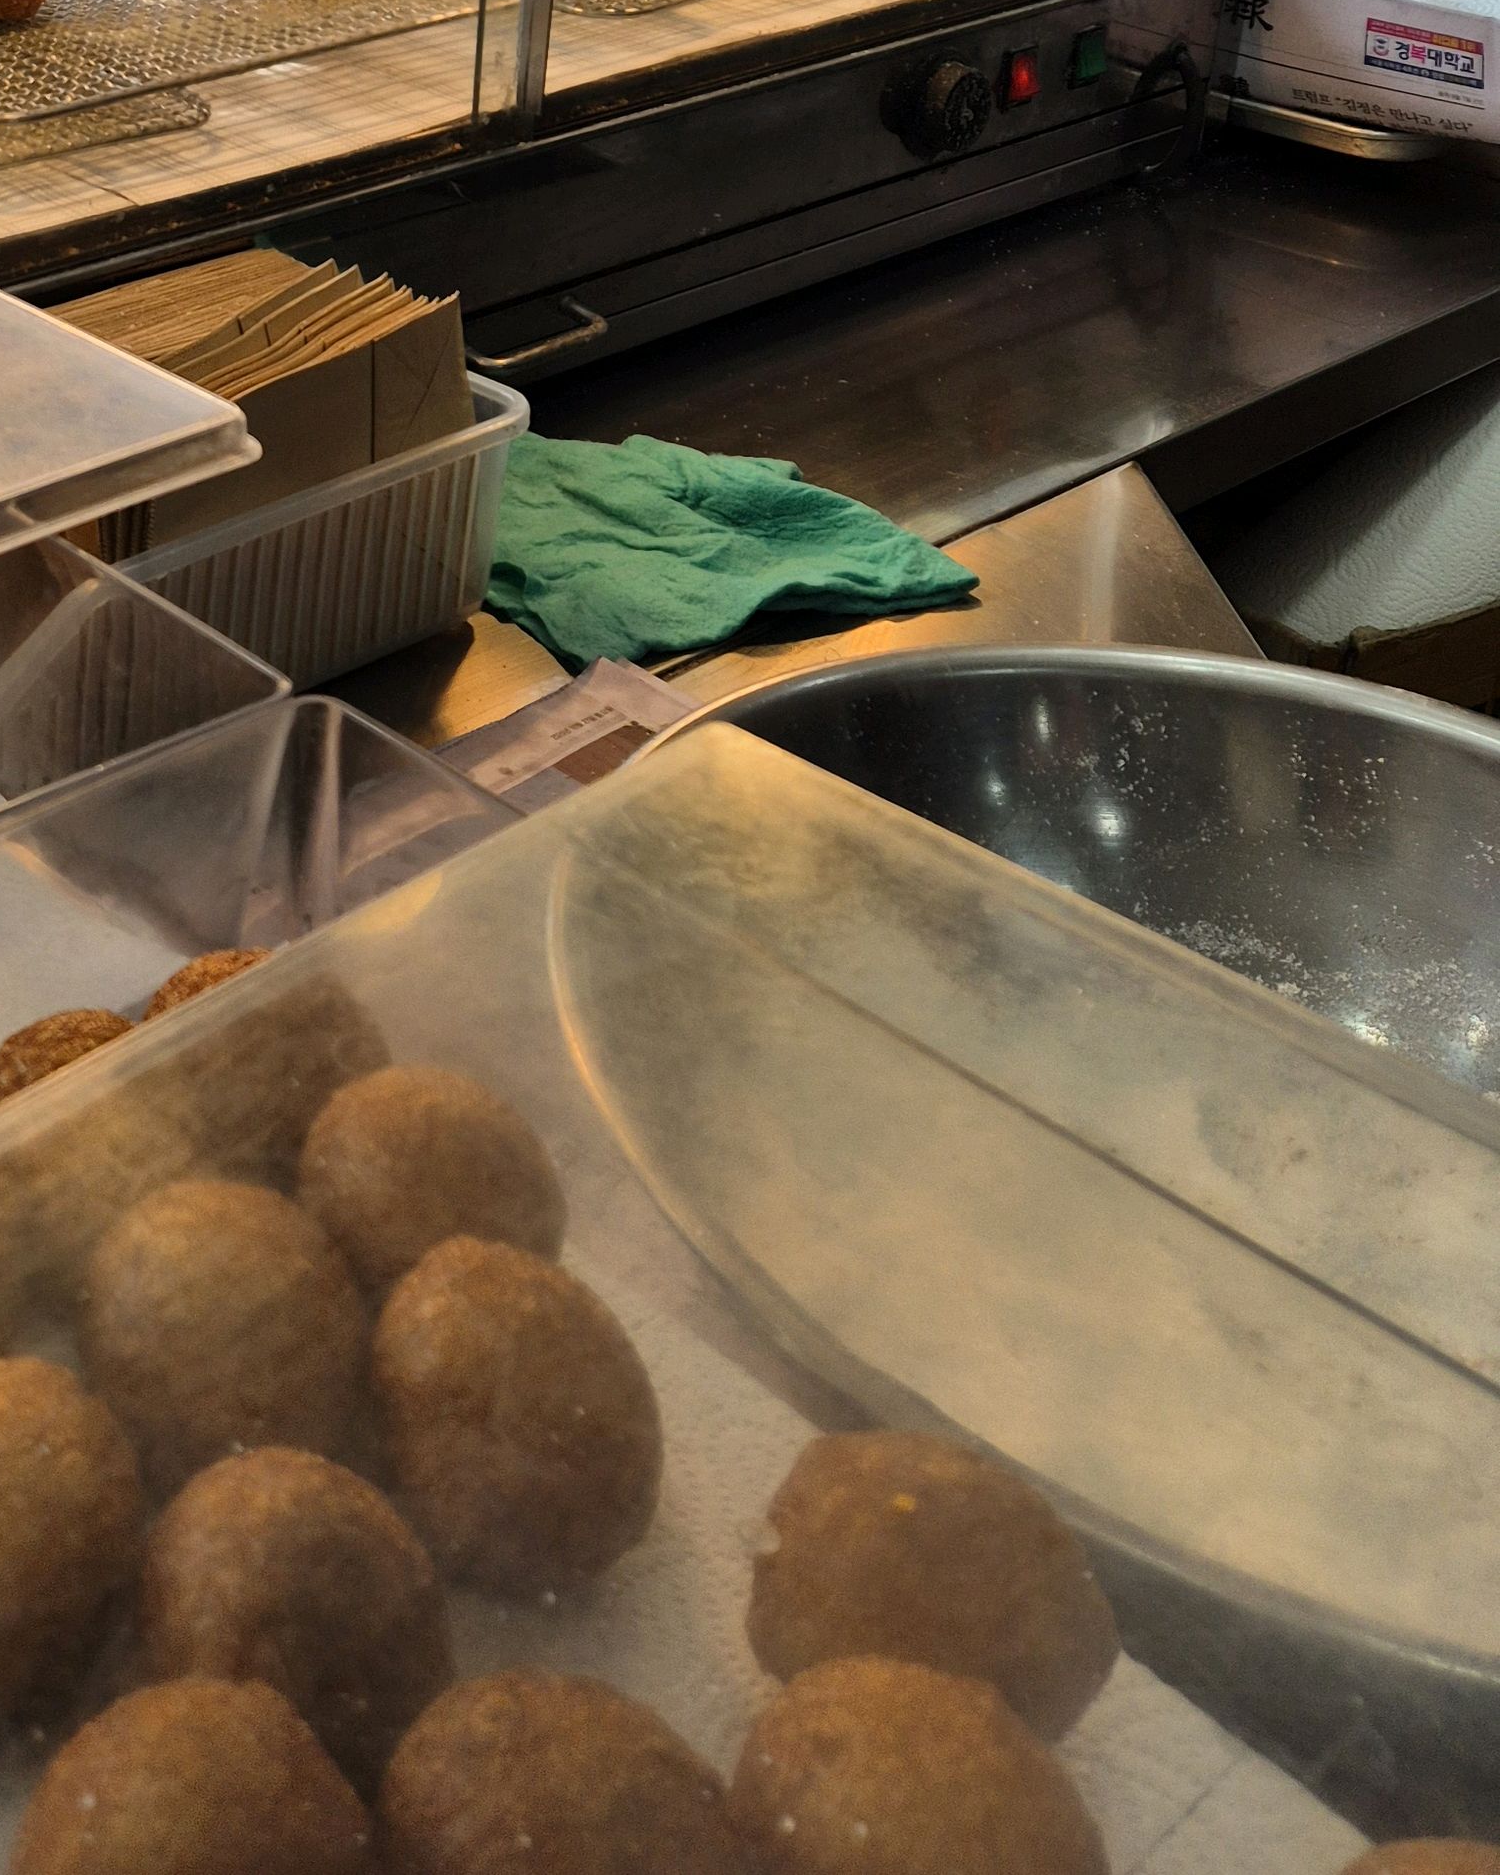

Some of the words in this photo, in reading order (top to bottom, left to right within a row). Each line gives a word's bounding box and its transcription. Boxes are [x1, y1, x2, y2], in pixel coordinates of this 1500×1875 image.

[1395, 41, 1475, 74] 경복대학교
[1292, 88, 1331, 106] 트럼프
[1389, 107, 1432, 127] 만나고
